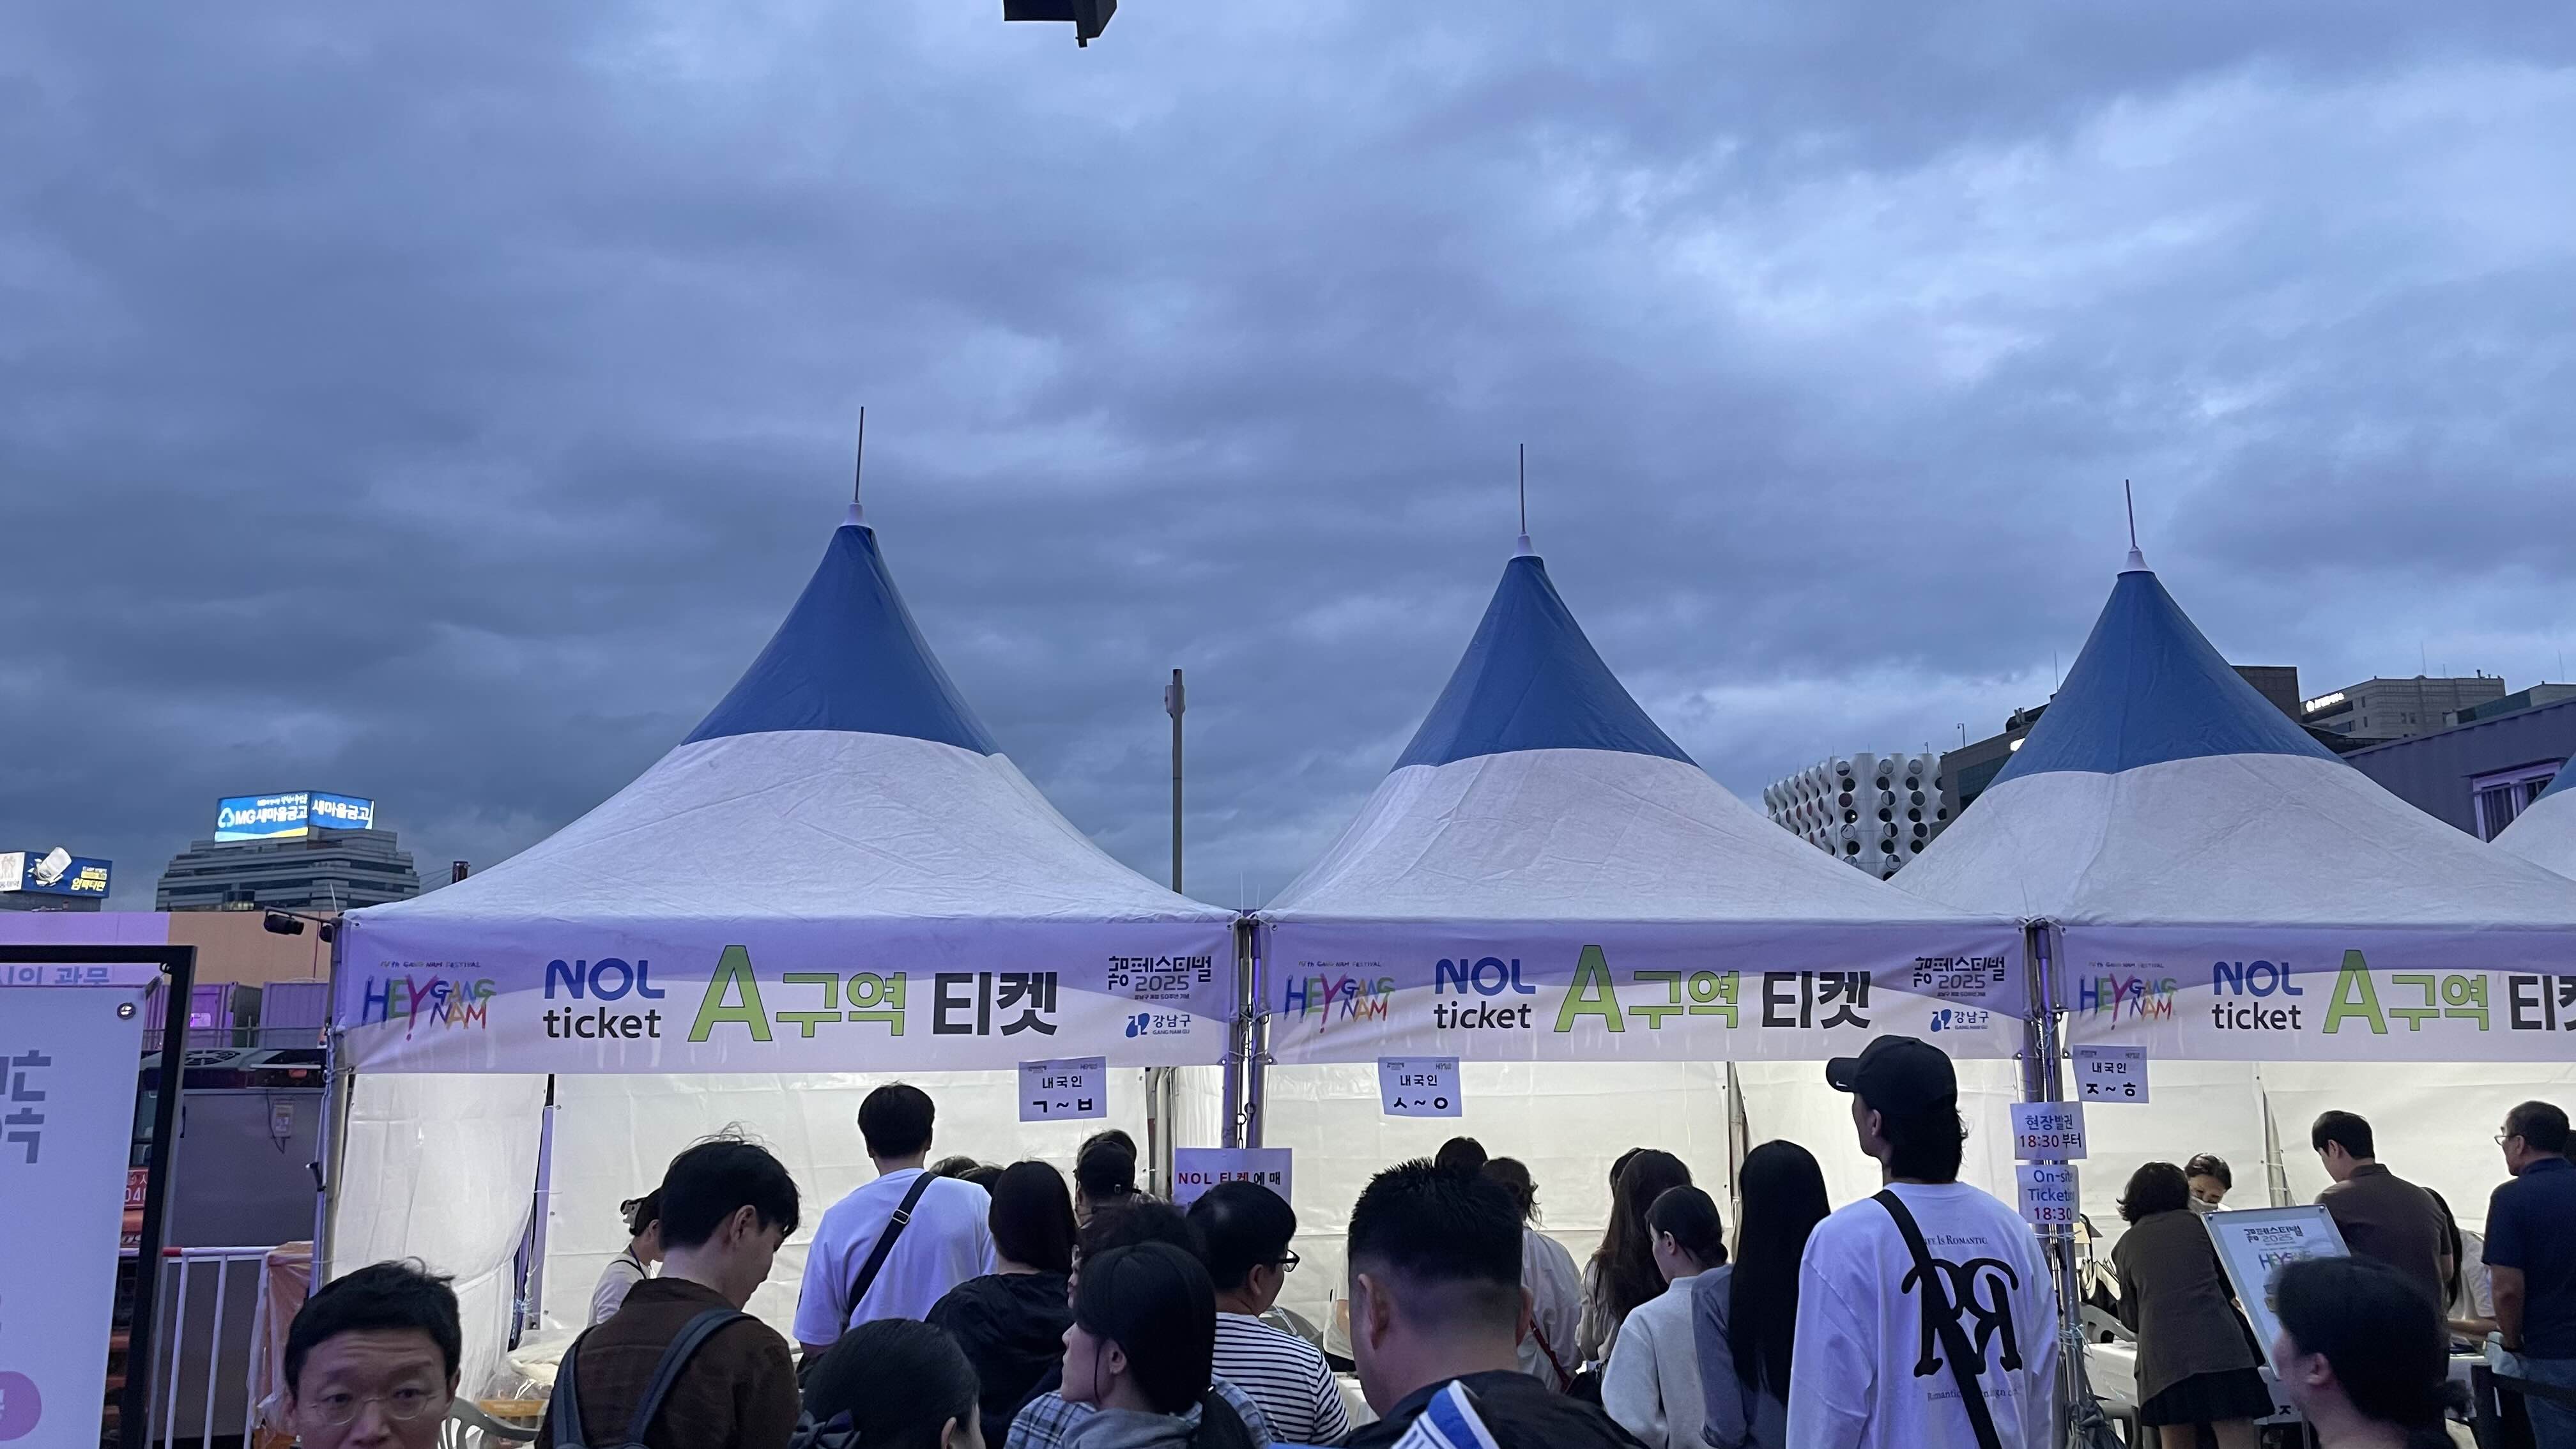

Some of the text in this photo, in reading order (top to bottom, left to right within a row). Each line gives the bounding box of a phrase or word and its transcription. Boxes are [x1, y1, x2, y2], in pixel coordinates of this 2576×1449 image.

[312, 799, 370, 820] 새마을금고
[544, 958, 666, 1001] NOL
[1135, 976, 1189, 992] 2025
[1435, 957, 1536, 996] NOL
[1938, 975, 1986, 989] 2025
[2214, 960, 2303, 997] NOL
[932, 972, 1058, 1036] 티켓
[1762, 971, 1871, 1029] 티켓
[543, 1006, 661, 1039] ticket
[1153, 1014, 1191, 1028] 강남구
[1434, 1000, 1531, 1029] ticket
[1954, 1011, 1989, 1023] 강남구
[2212, 1002, 2302, 1030] ticket
[2092, 1062, 2126, 1073] 내국인
[1042, 1075, 1082, 1089] 내국인
[1400, 1075, 1438, 1086] 내국인
[2025, 1114, 2074, 1131] 현장발권
[1179, 1172, 1212, 1184] NOL
[2034, 1207, 2072, 1220] 18:30
